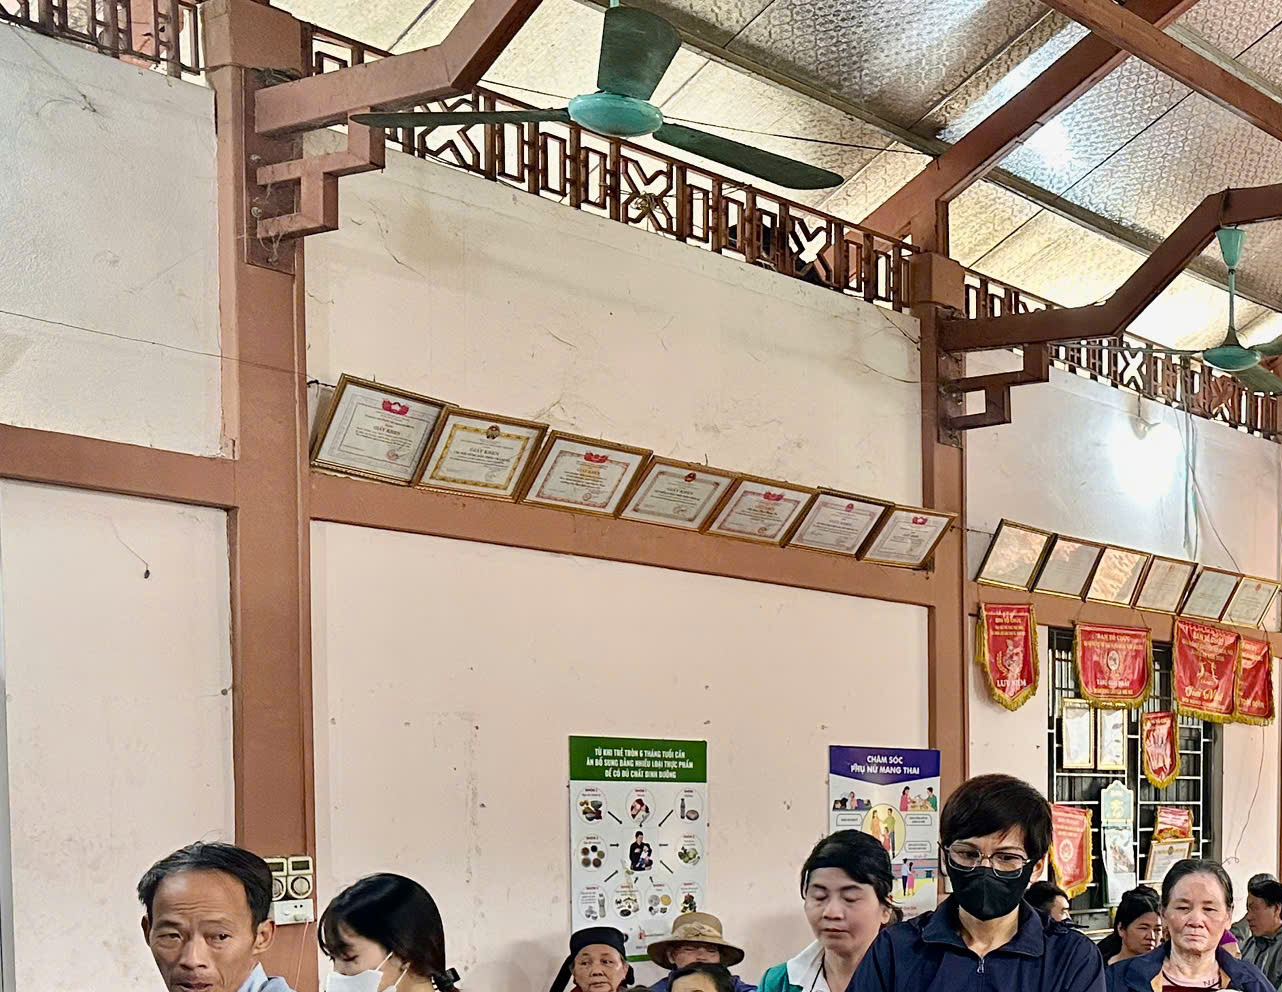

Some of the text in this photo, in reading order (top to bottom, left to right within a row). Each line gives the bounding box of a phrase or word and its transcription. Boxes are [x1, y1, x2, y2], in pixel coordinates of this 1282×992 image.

[595, 746, 602, 756] TỪ
[614, 747, 624, 756] TRẺ
[644, 748, 661, 758] THÁNG
[662, 749, 674, 758] TUỔI
[675, 750, 685, 758] CẦN
[595, 756, 603, 766] BỔ
[635, 758, 650, 767] NHIỀU
[652, 761, 663, 769] LOẠI
[664, 761, 677, 769] THỰC
[679, 759, 693, 768] PHẨM
[867, 755, 903, 764] CHĂM SÓC
[613, 768, 620, 777] CÓ
[631, 768, 643, 778] CHẤT
[851, 764, 865, 775] PHỤ
[867, 764, 877, 773] NỮ
